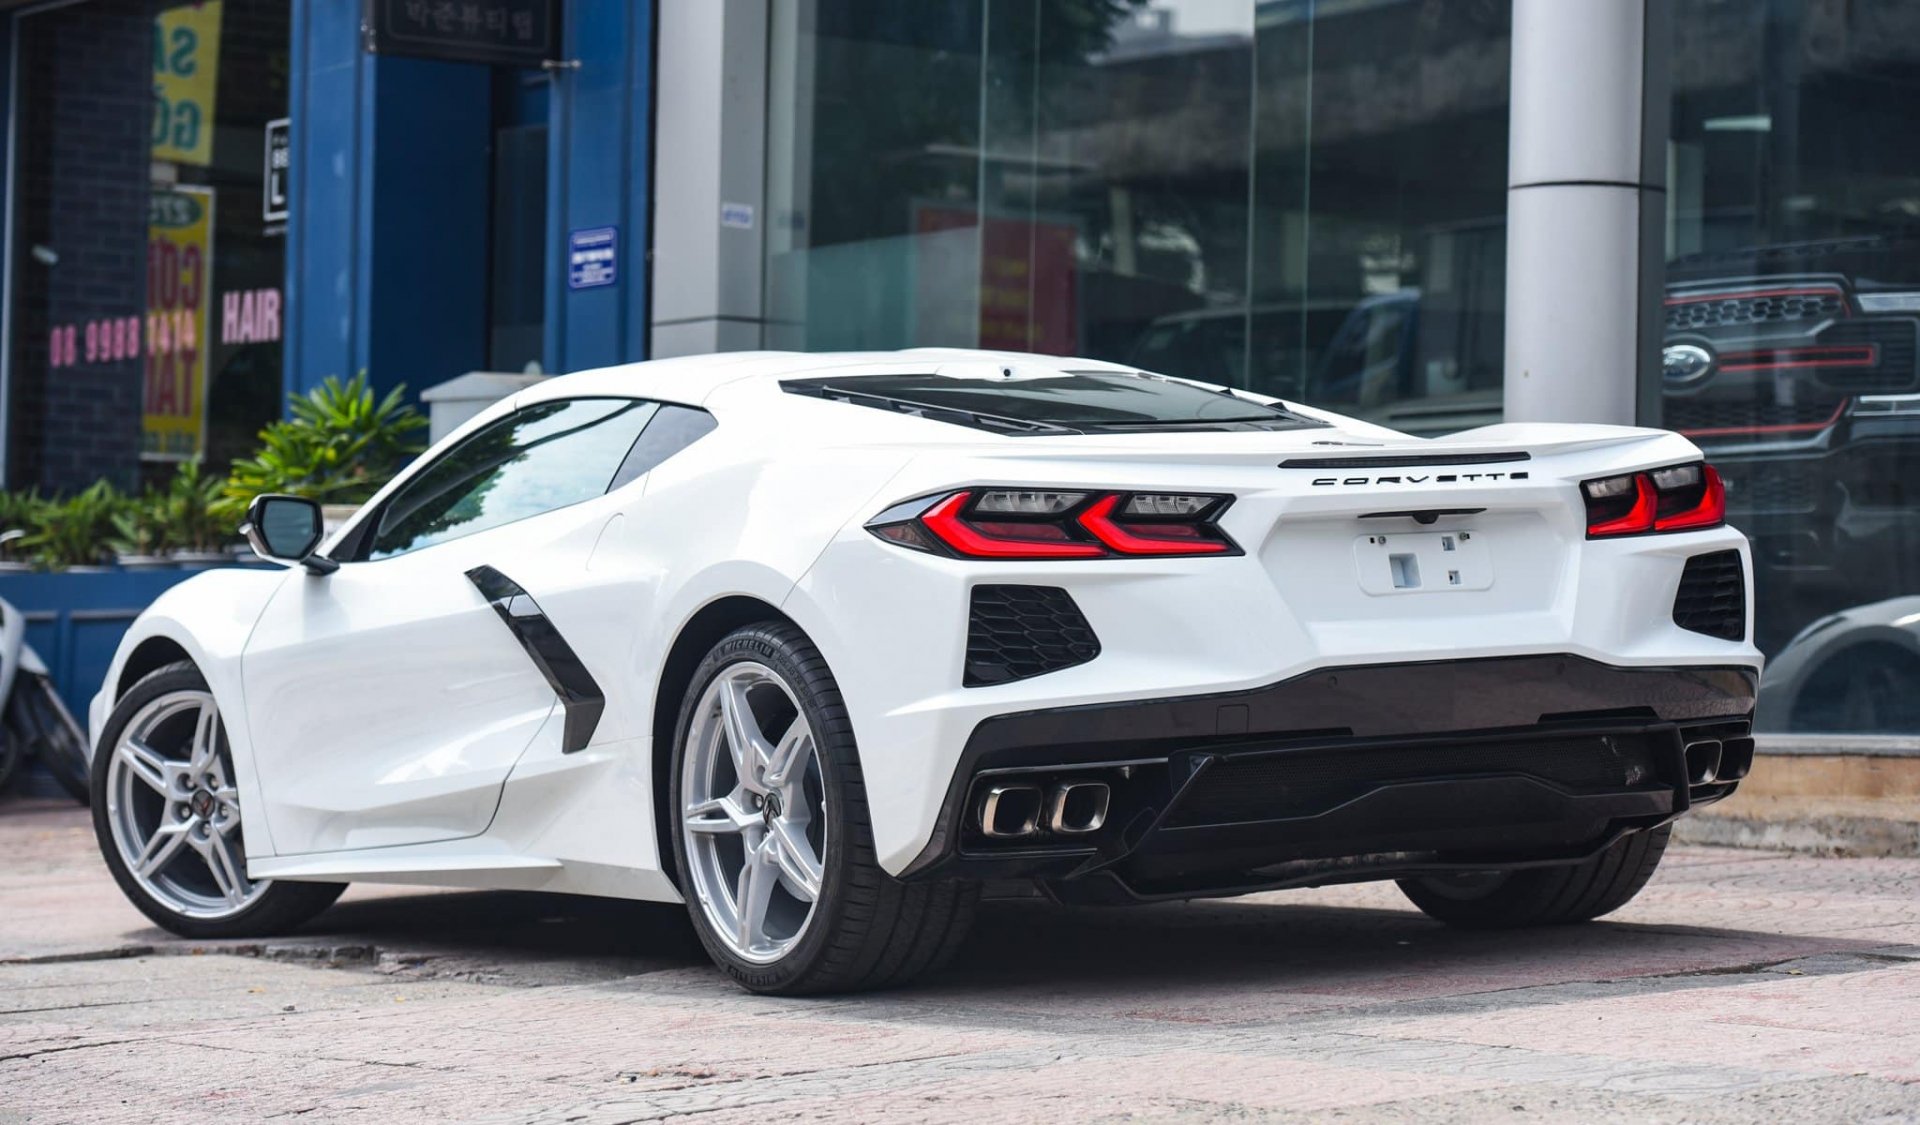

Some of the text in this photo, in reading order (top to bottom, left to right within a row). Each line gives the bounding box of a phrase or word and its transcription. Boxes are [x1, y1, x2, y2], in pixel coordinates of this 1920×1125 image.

[222, 288, 281, 344] HAIR
[1311, 471, 1529, 486] CORVETTE
[724, 638, 773, 658] MICHELIN
